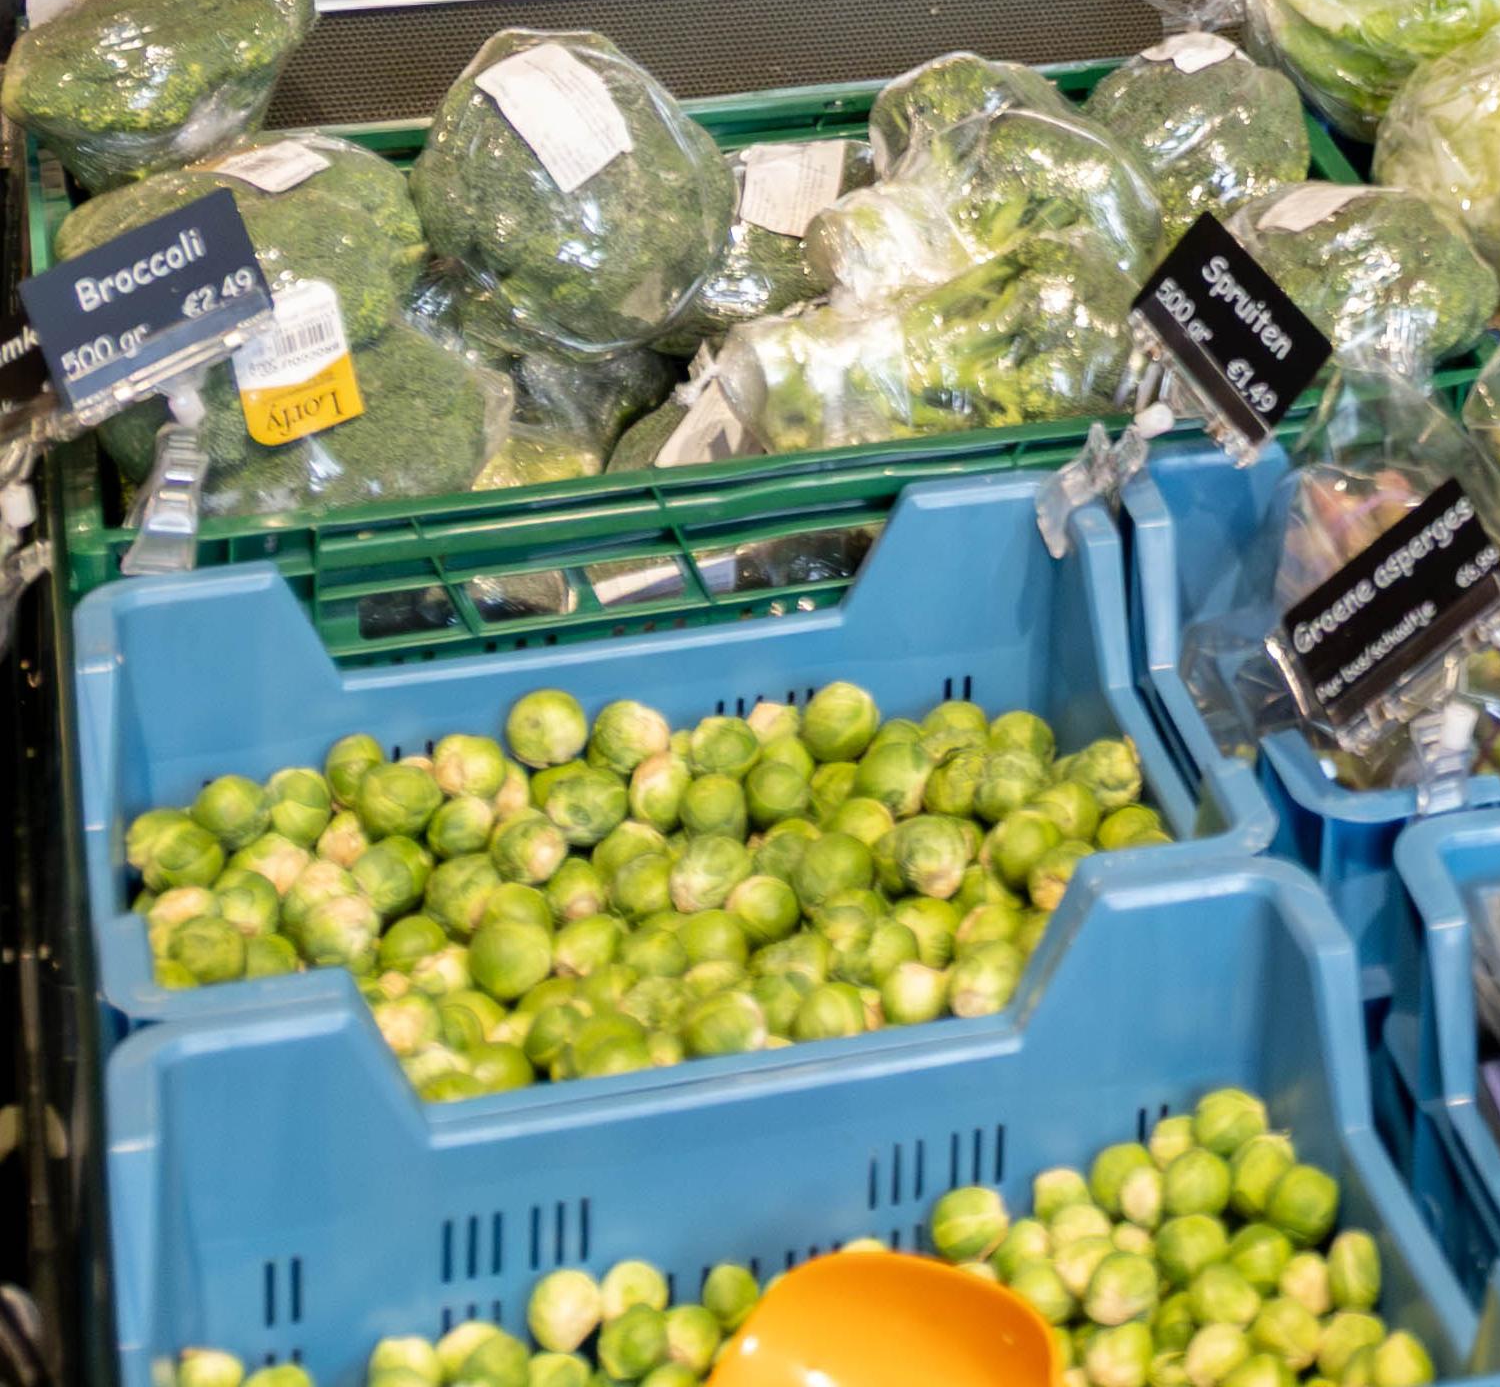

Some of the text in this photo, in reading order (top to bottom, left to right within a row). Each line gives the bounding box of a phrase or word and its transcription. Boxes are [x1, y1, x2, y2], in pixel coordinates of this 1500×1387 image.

[74, 228, 207, 313] Broccoli
[1155, 277, 1196, 323] 500
[1187, 319, 1214, 343] gr
[1202, 255, 1293, 361] Spruiten
[60, 335, 112, 378] 500
[119, 323, 150, 359] gr
[1293, 495, 1475, 655] Groene asperges
